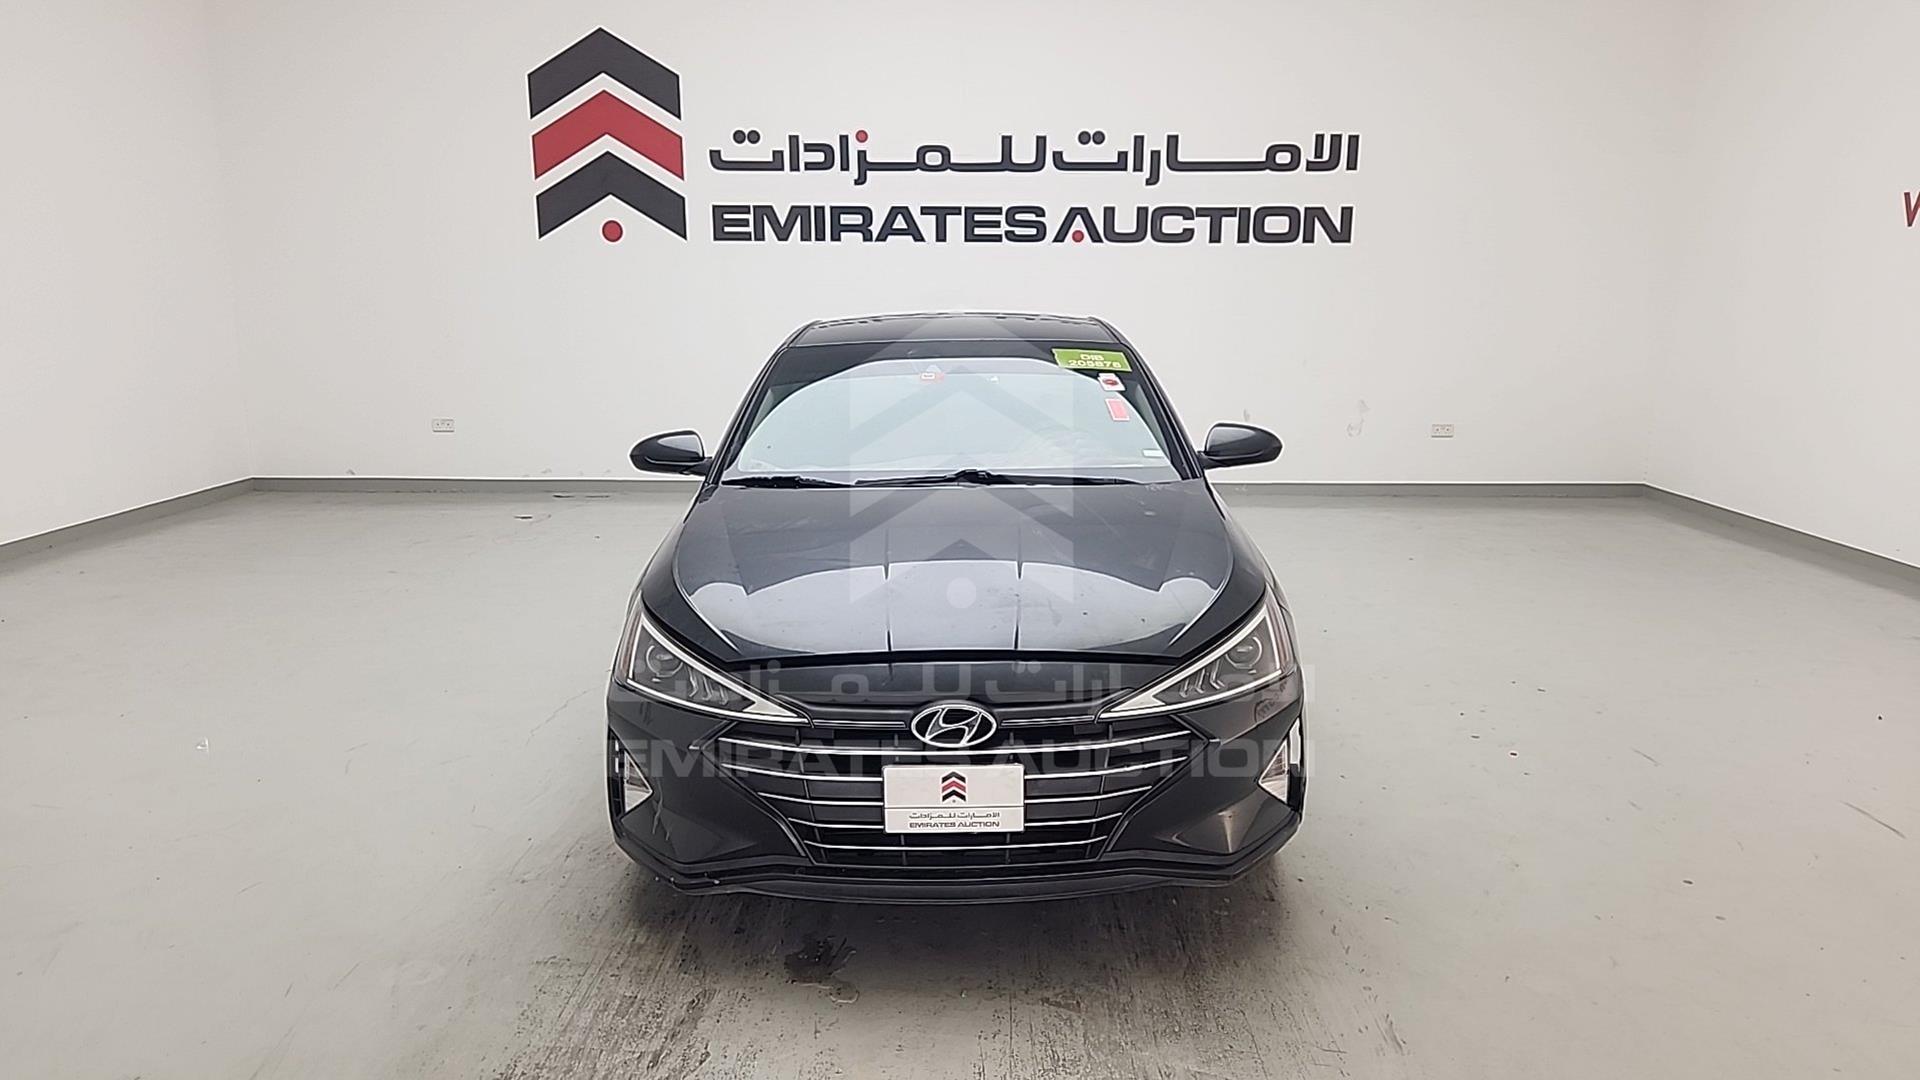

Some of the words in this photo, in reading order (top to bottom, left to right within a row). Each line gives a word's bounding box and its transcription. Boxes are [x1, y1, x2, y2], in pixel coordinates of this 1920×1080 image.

[709, 129, 1047, 186] للمزادات
[712, 204, 1047, 242] EMIRATES
[1052, 206, 1354, 243] AUCTION
